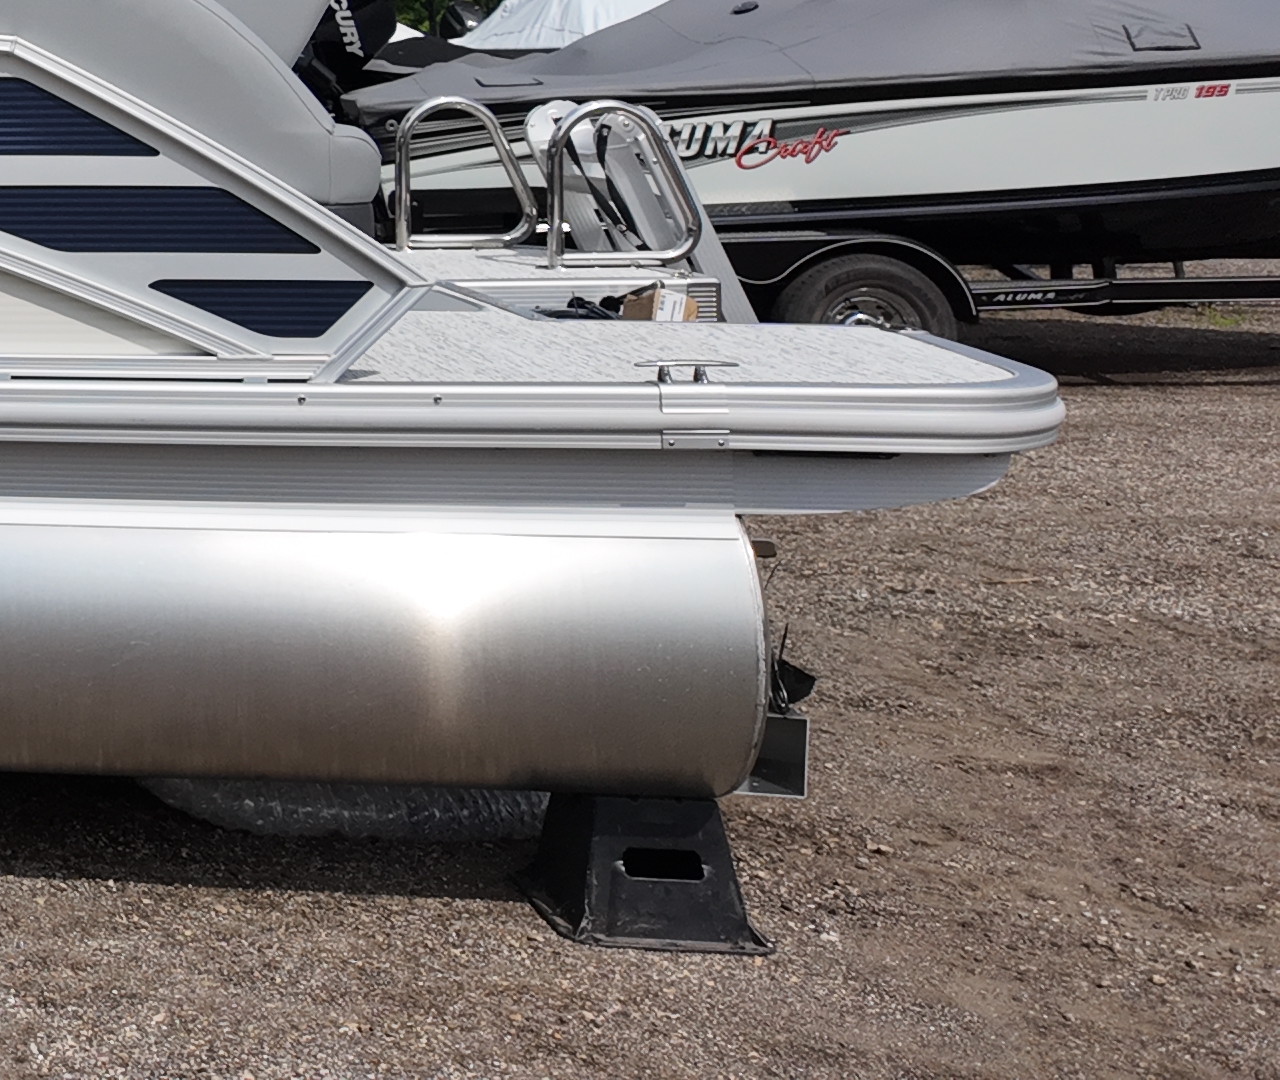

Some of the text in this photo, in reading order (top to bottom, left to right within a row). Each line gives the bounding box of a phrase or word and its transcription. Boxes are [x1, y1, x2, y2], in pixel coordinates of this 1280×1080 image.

[1194, 83, 1231, 98] 195
[735, 127, 850, 170] Craft
[992, 292, 1056, 302] ALUMA
